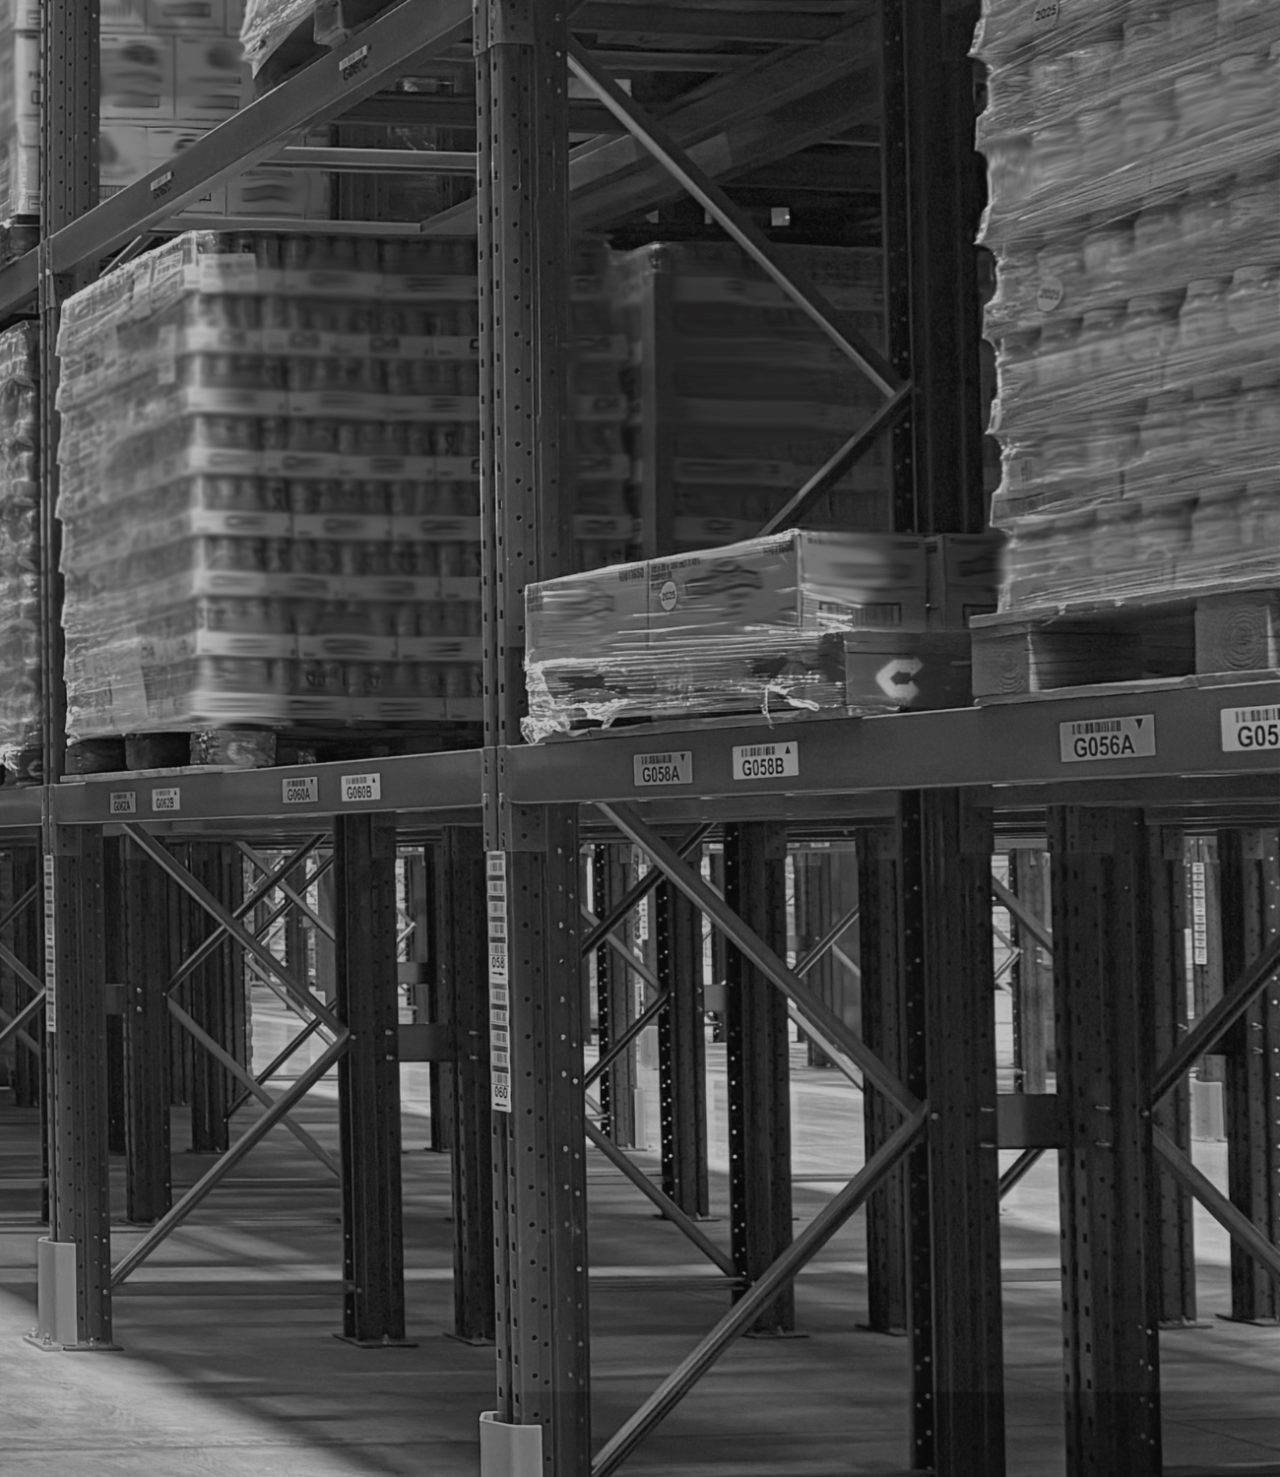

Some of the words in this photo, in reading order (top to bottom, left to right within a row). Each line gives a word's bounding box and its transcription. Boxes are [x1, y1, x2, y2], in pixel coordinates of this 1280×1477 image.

[1074, 734, 1135, 758] G056A
[642, 765, 680, 783] G058A
[742, 757, 784, 777] G058B
[287, 788, 311, 801] G060A
[346, 785, 372, 800] G060B
[491, 956, 505, 969] 058
[494, 1086, 508, 1099] 060
